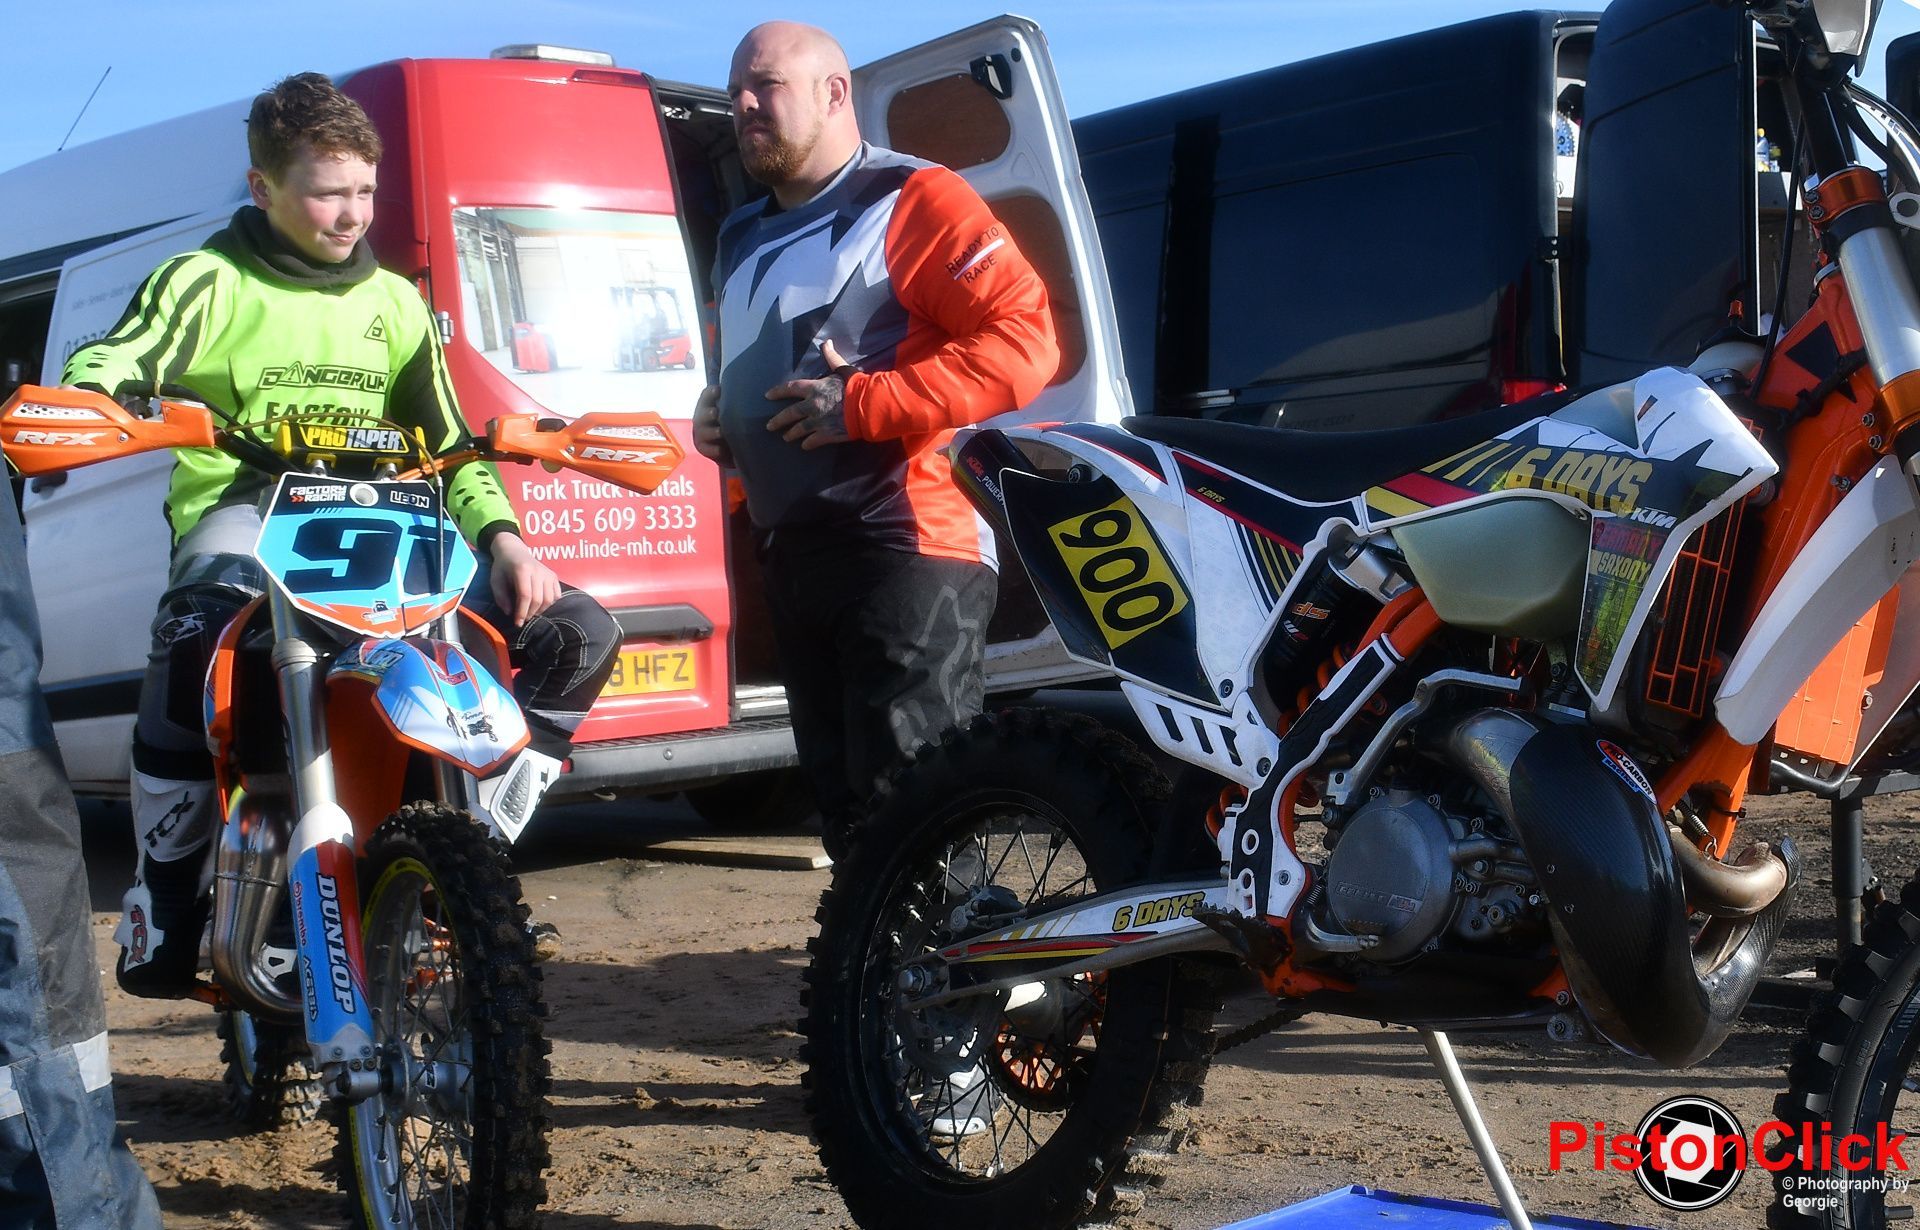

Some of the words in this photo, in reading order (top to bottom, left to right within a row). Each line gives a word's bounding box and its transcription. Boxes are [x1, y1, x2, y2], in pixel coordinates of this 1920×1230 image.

[945, 235, 983, 274] READY
[984, 226, 999, 240] TO
[964, 254, 997, 283] RACE
[13, 430, 108, 445] RFX
[580, 446, 666, 464] RFX
[522, 478, 567, 501] Fork
[571, 479, 623, 499] Truck
[1504, 447, 1551, 490] 6
[1542, 451, 1653, 518] DAYS
[390, 491, 430, 509] LEON
[525, 509, 585, 536] 0845
[594, 507, 636, 532] 609
[644, 504, 697, 530] 3333
[1630, 506, 1677, 529] KTM
[528, 534, 697, 560] www.linde-mh.co.uk
[1059, 509, 1175, 632] 900
[1597, 551, 1652, 583] SAXONY
[633, 652, 690, 685] HFZ
[1112, 905, 1133, 932] 6
[1133, 891, 1206, 928] DAYS
[316, 872, 356, 1014] DUNLOP
